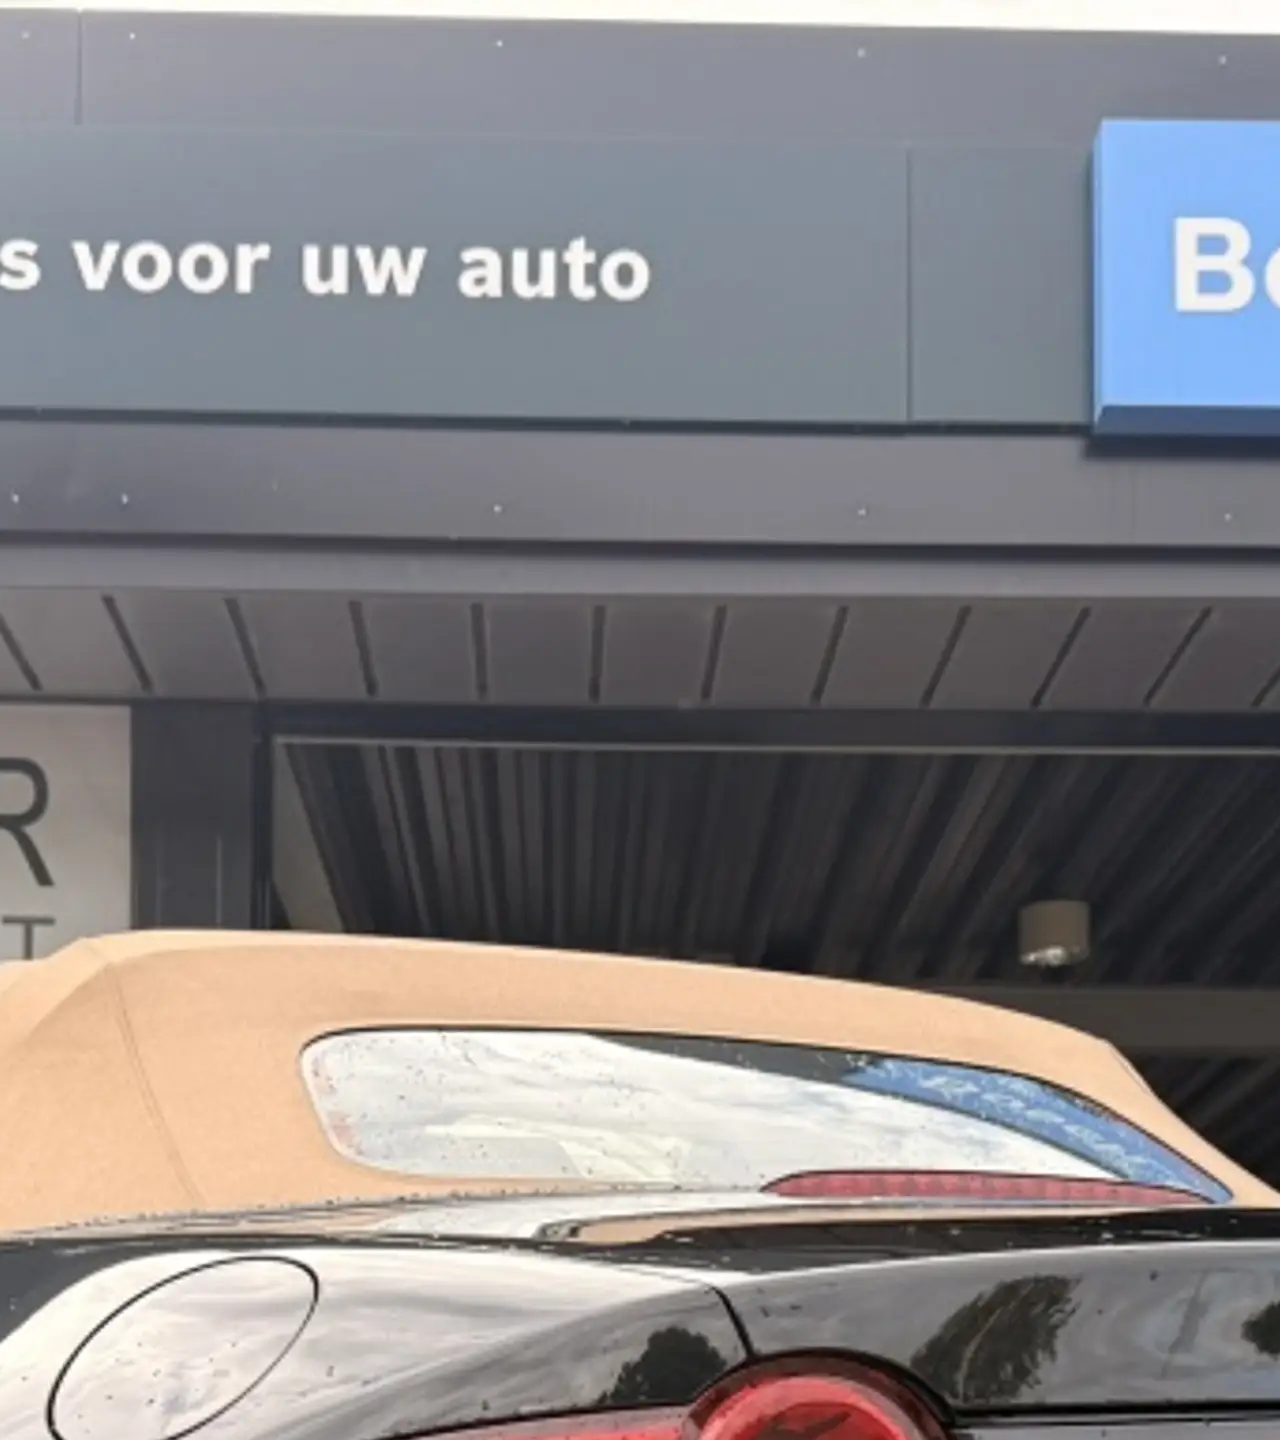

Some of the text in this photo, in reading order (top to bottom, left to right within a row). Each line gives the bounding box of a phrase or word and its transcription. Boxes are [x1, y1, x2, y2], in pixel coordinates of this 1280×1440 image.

[71, 239, 271, 294] voor
[301, 244, 427, 296] uw
[458, 236, 651, 301] auto
